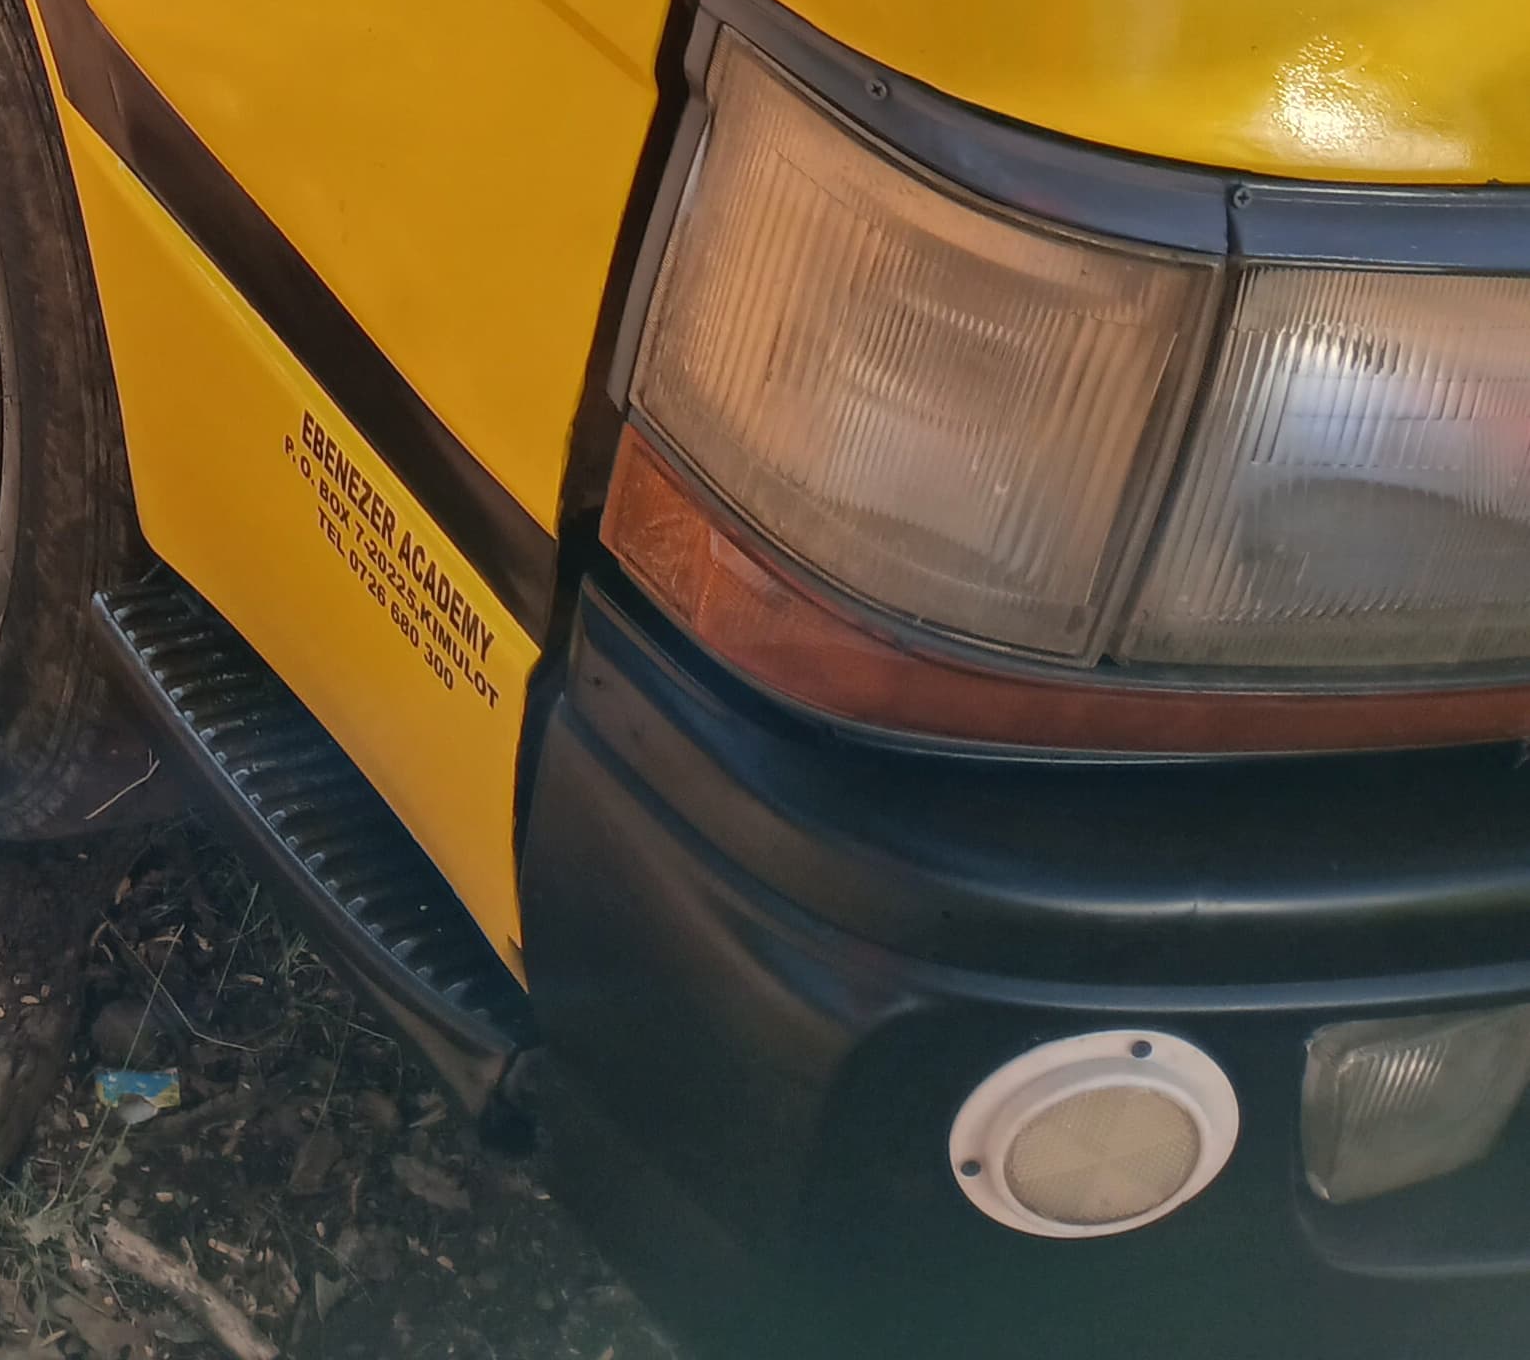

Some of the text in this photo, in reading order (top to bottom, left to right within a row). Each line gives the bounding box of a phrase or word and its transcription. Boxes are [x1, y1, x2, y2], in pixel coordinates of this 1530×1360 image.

[302, 409, 494, 663] EBENEZER ACADEMY
[318, 479, 350, 530] BOX
[317, 506, 454, 691] TEL 0726 680 300
